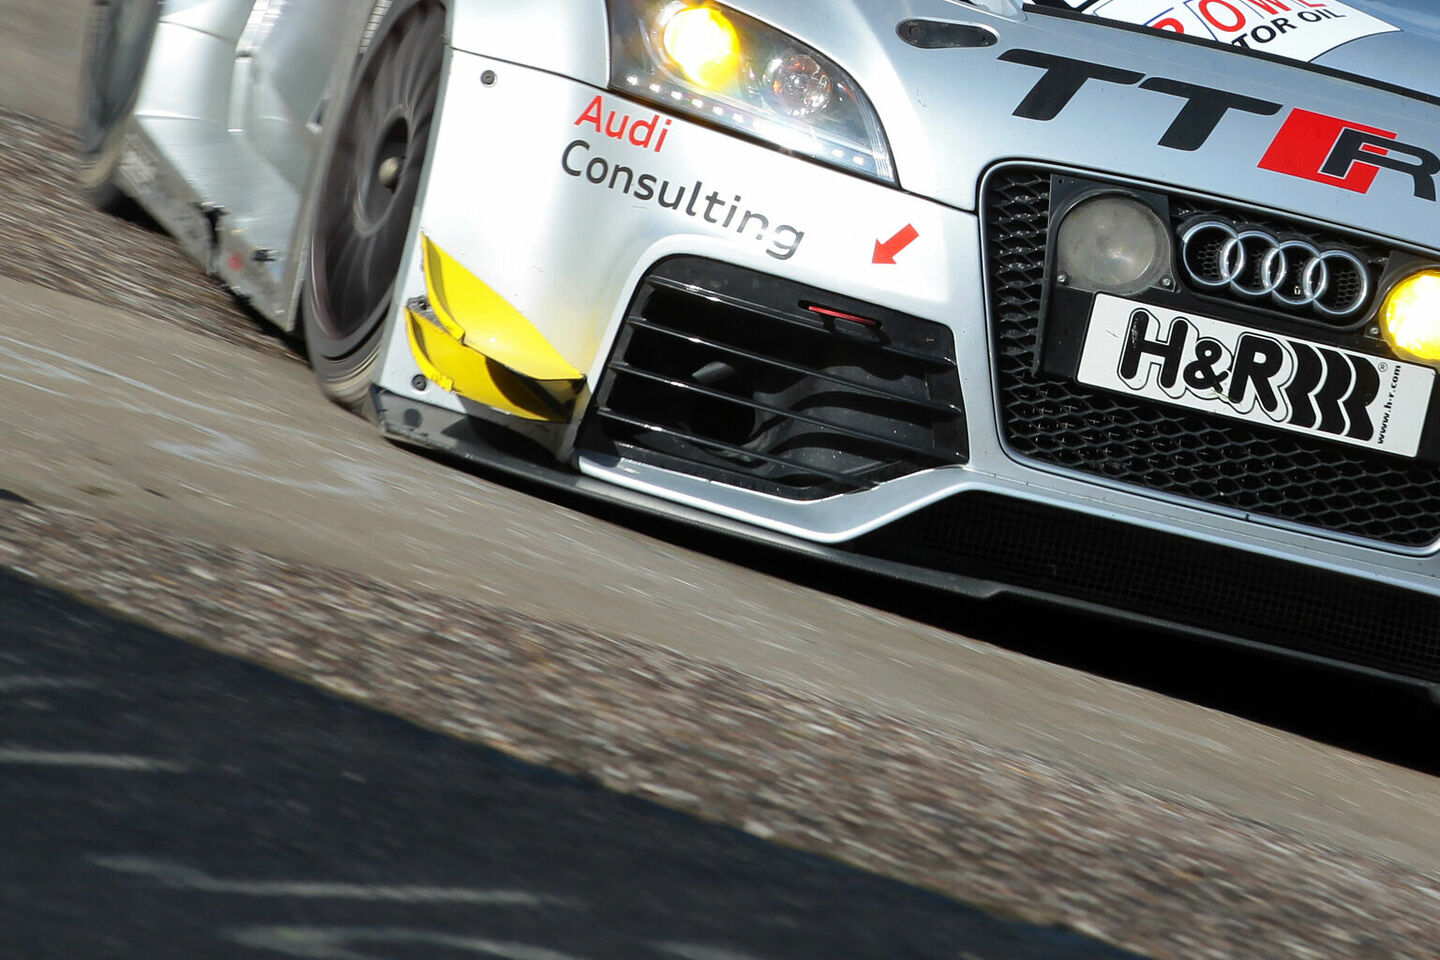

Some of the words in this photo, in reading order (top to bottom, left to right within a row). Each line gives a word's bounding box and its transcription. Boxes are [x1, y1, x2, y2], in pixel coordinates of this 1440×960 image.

[1297, 8, 1347, 23] OIL
[574, 95, 673, 153] Audi
[561, 139, 805, 261] Consulting
